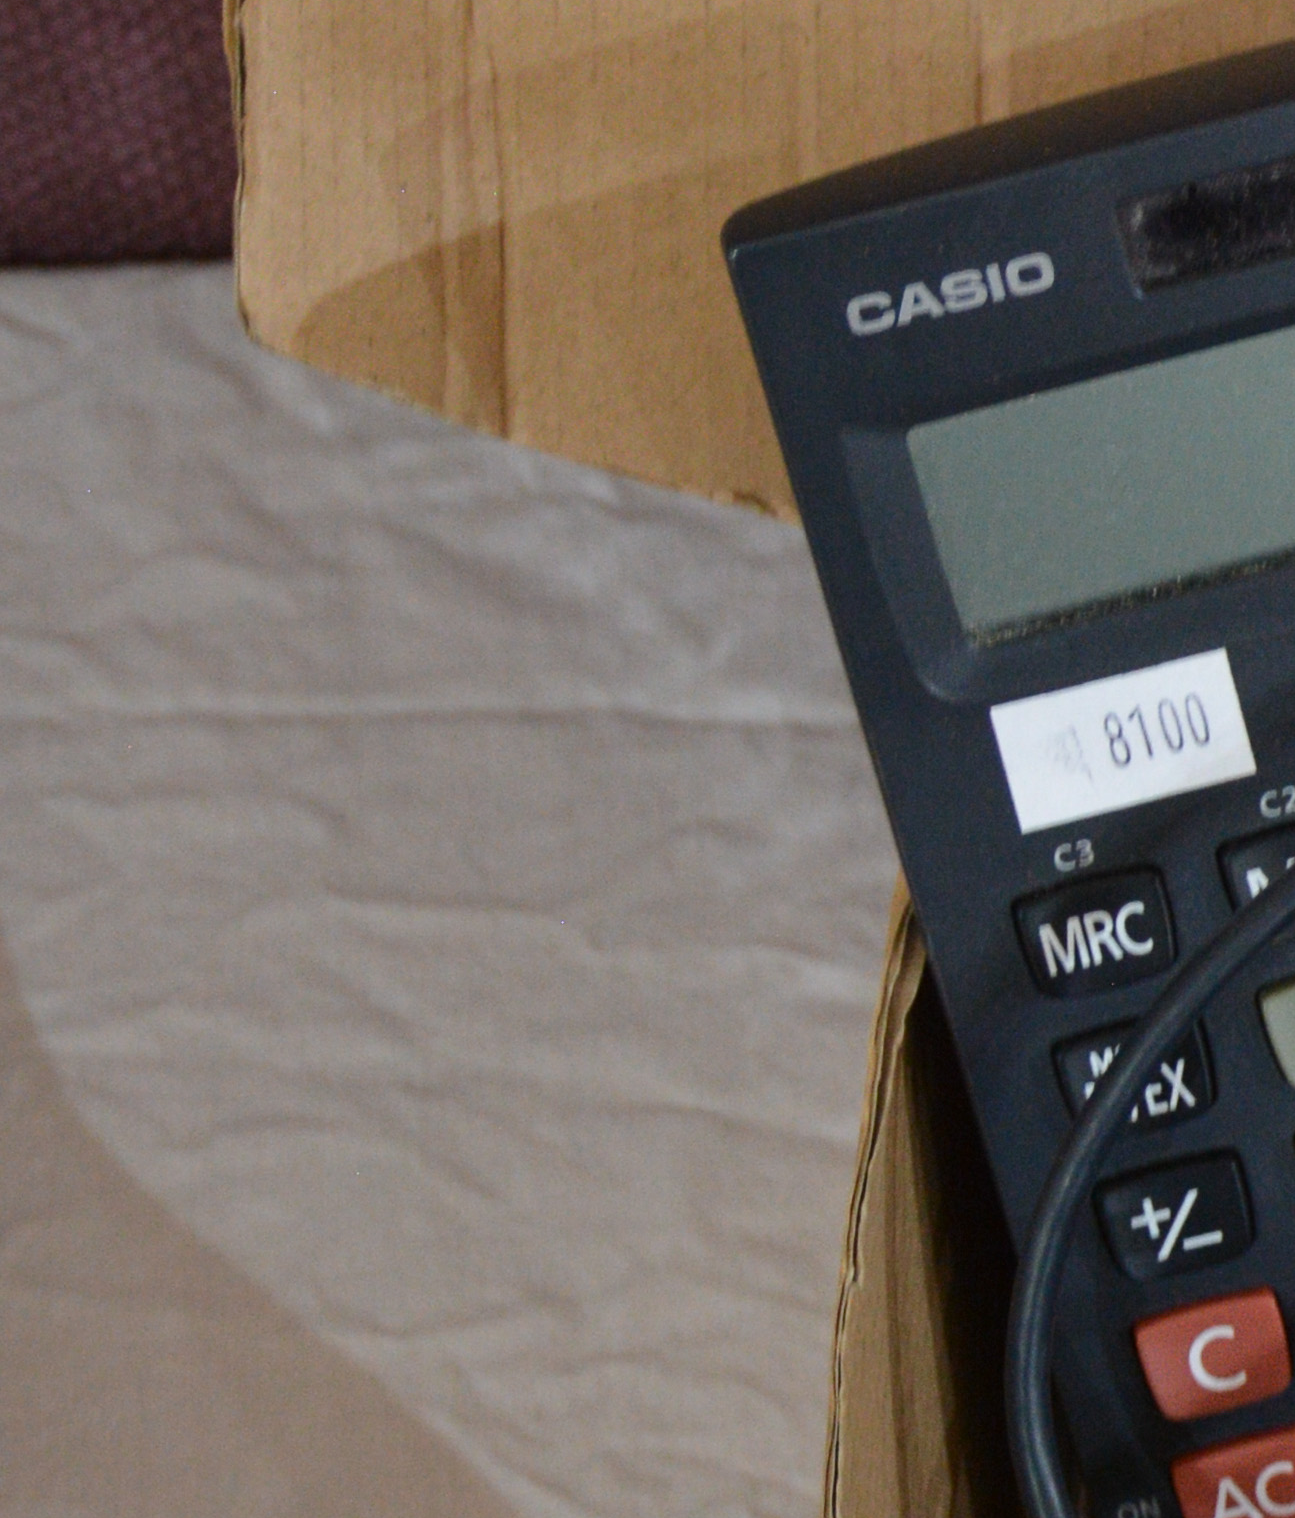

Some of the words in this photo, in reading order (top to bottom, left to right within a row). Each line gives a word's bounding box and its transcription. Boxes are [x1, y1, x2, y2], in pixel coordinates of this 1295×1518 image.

[846, 251, 1055, 337] CASIO
[1103, 691, 1212, 769] 8100
[1053, 838, 1096, 873] C3
[1038, 899, 1154, 978] MRC
[1188, 1323, 1247, 1393] C
